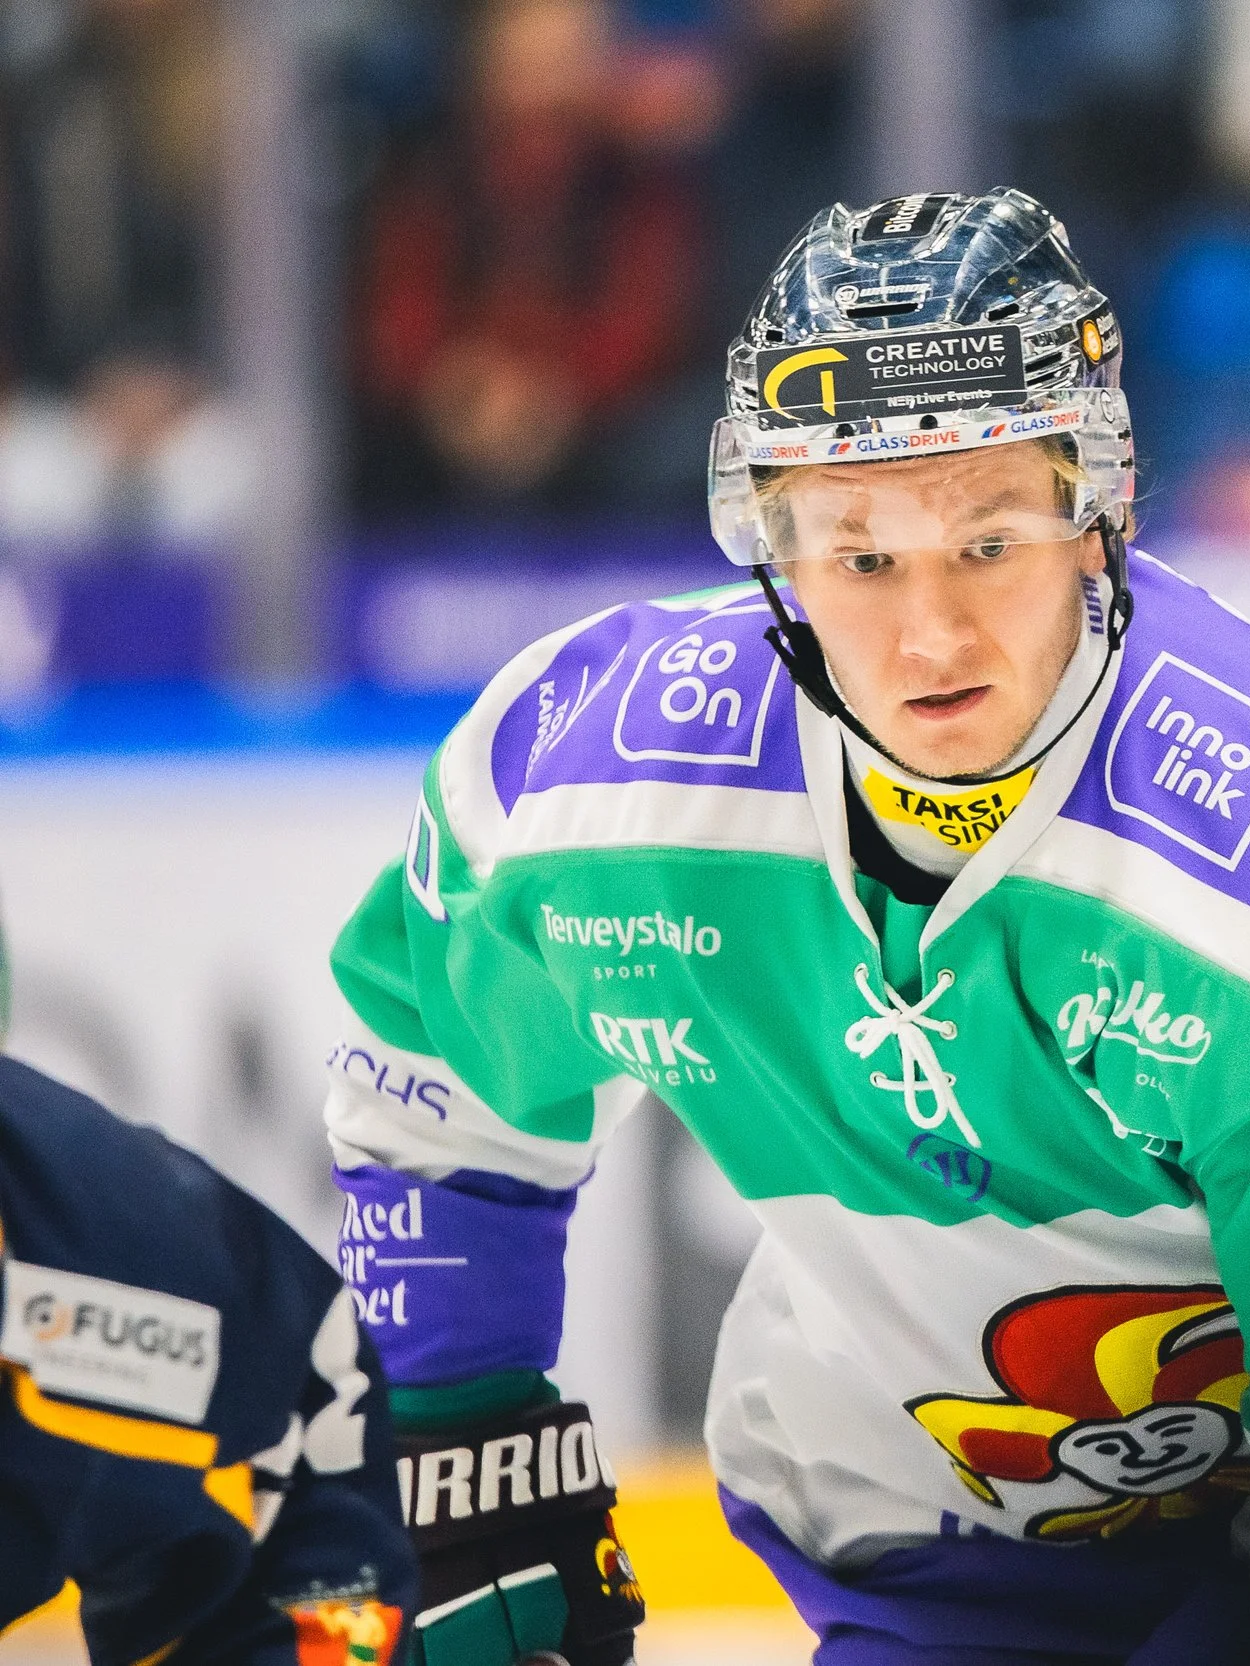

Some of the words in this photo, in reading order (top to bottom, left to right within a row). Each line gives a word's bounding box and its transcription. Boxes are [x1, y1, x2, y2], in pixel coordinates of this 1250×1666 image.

[865, 334, 1005, 363] CREATIVE
[868, 355, 1006, 379] TECHNOLOGY
[916, 392, 945, 404] Live
[946, 389, 992, 402] Events
[1011, 410, 1080, 433] GLASSDRIVE
[857, 431, 960, 452] GLASSDRIVE
[657, 633, 737, 675] Go
[659, 676, 742, 729] On
[1152, 746, 1246, 820] link
[892, 786, 1003, 822] TAKSI
[540, 903, 722, 956] Terveystalo
[593, 963, 657, 981] SPORT
[590, 1012, 711, 1066] RTK
[72, 1301, 205, 1368] FUGUS
